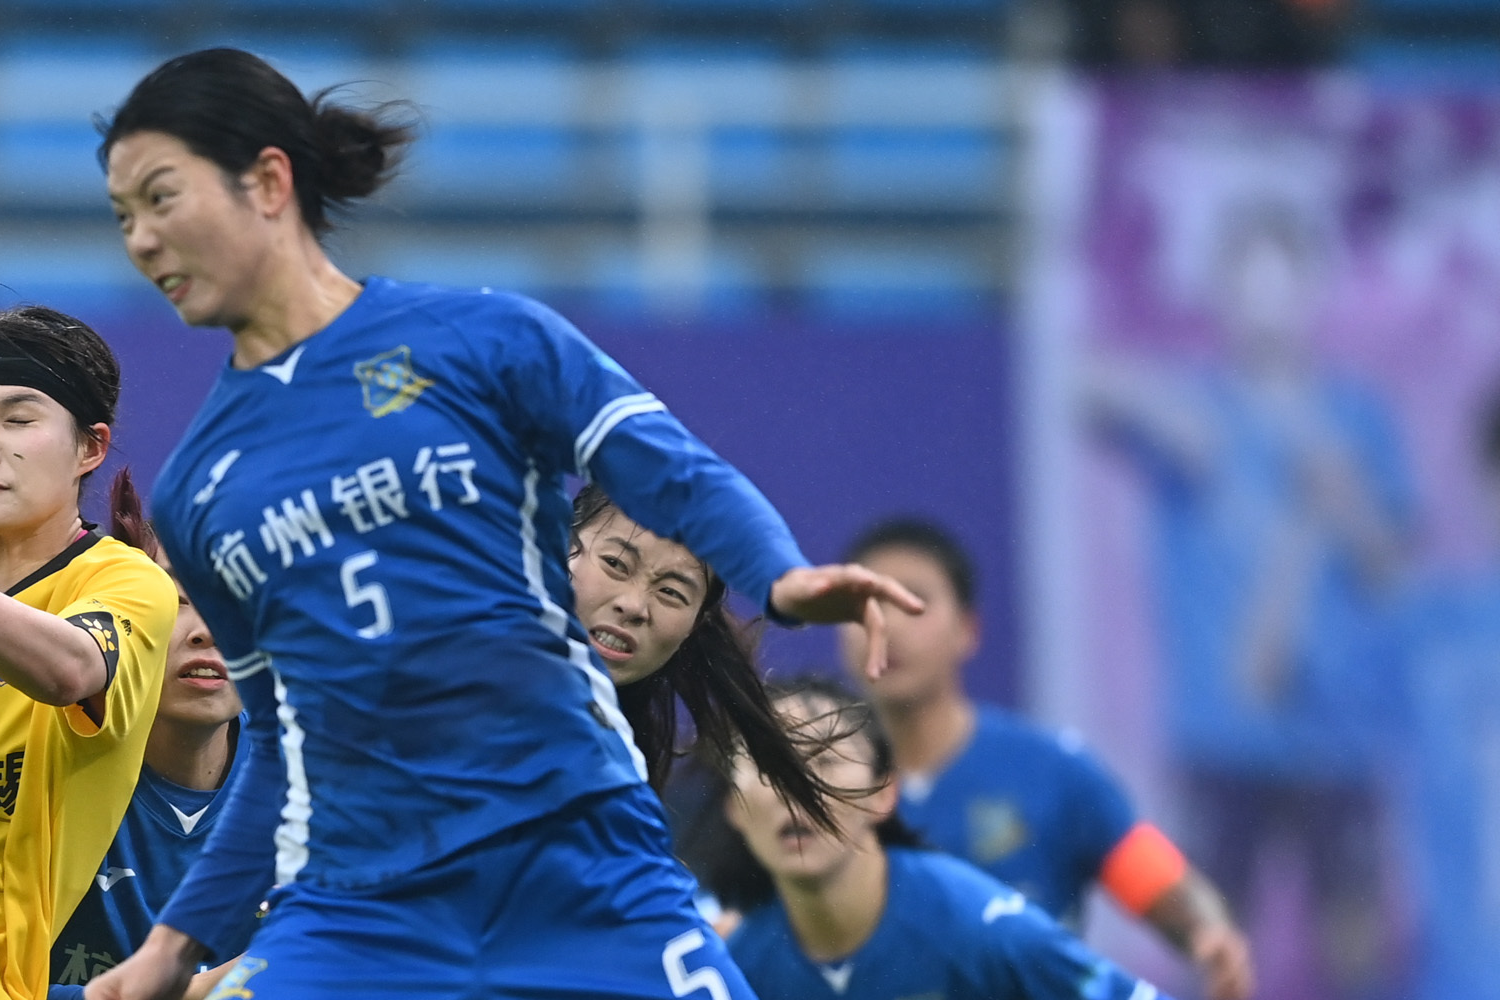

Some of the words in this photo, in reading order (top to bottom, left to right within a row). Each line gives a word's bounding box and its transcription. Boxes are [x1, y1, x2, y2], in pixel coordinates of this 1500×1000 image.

[210, 442, 481, 600] 杭州银行
[339, 550, 394, 639] 5
